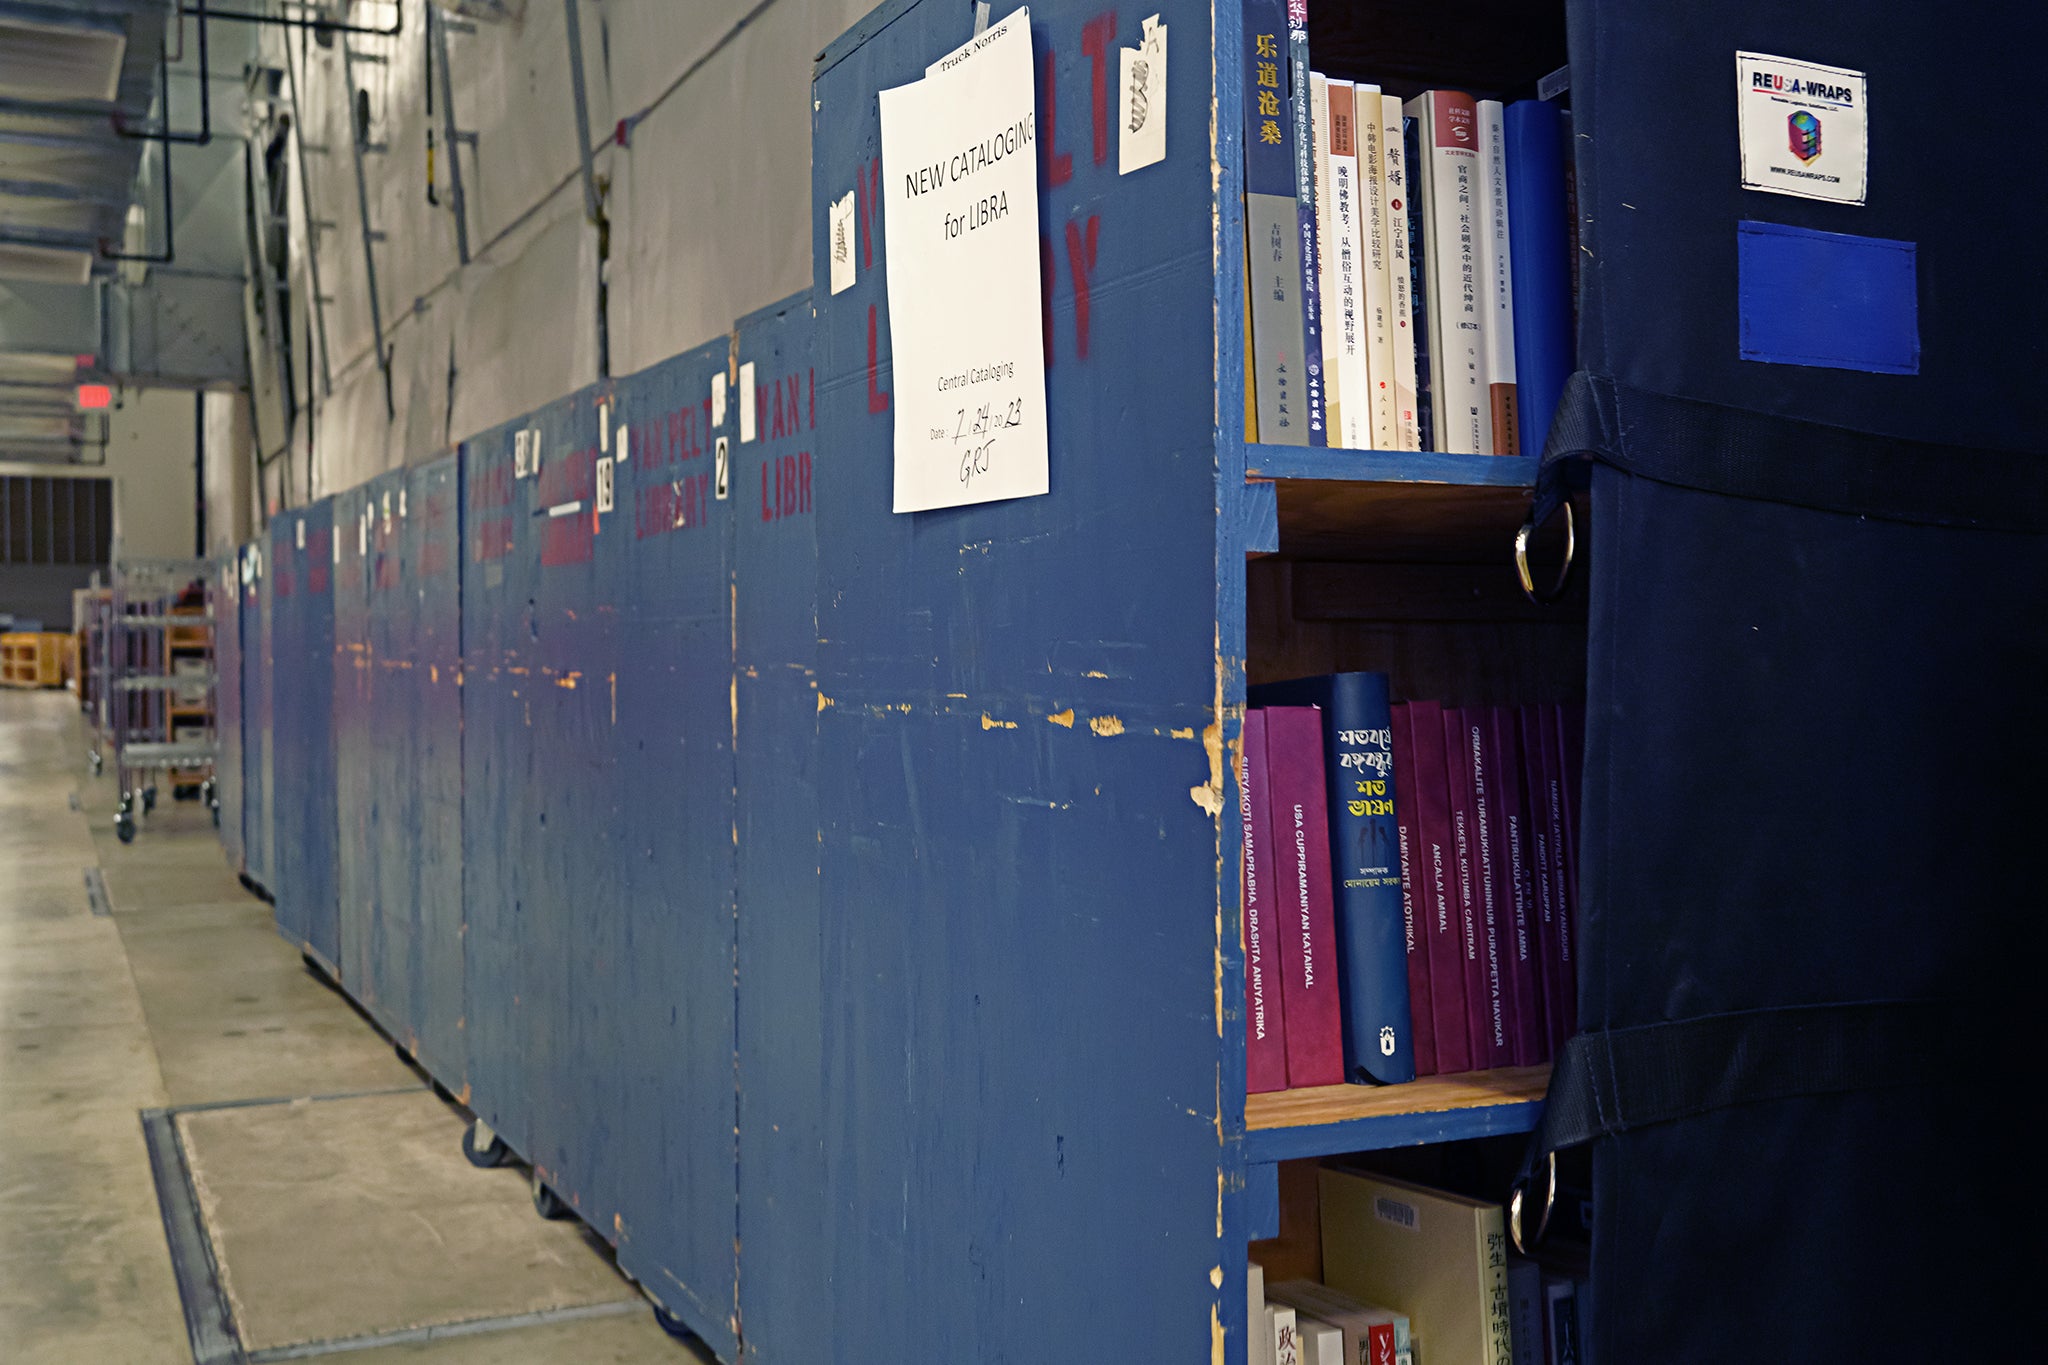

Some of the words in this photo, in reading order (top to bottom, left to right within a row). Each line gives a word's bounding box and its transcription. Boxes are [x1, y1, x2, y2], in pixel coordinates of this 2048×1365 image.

[940, 48, 971, 72] Truck
[974, 25, 1008, 53] Norris
[1255, 33, 1282, 145] 乐道沧桑
[1752, 71, 1853, 102] REUSA-WRAPS
[906, 161, 946, 199] NEW
[950, 112, 1033, 182] CATALOGING
[944, 212, 966, 240] for
[969, 190, 1009, 231] LIBRA
[1456, 164, 1475, 313] 官商之间：社会剧变中的近代绅商
[937, 369, 969, 392] Central
[970, 361, 1014, 384] Cataloging
[717, 441, 727, 495] 2
[1472, 726, 1484, 795] ORMAKALITE
[1347, 799, 1394, 817] ভাষণ
[1355, 780, 1386, 797] শত
[1293, 804, 1304, 828] USA
[1456, 810, 1467, 856] TEKKETIL
[1243, 823, 1257, 906] SAMAPRABHA,
[1295, 829, 1310, 931] CUPPIRAMANIYAN
[1399, 826, 1411, 889] DAMIYANTE
[1432, 843, 1444, 892] ANCALAI
[1460, 858, 1471, 907] KUTUMBA
[1249, 909, 1261, 964] DRASHTA
[1403, 892, 1415, 954] ATOTHIKAL
[1437, 894, 1448, 934] AMMAL
[1465, 910, 1476, 960] CARITRAM
[1302, 932, 1314, 990] KATAIKAL
[1487, 928, 1500, 998] PURAPPETTA
[1517, 928, 1527, 961] AMMA
[1252, 966, 1265, 1041] ANUYATRIKA
[1492, 999, 1504, 1047] NAVIKAR
